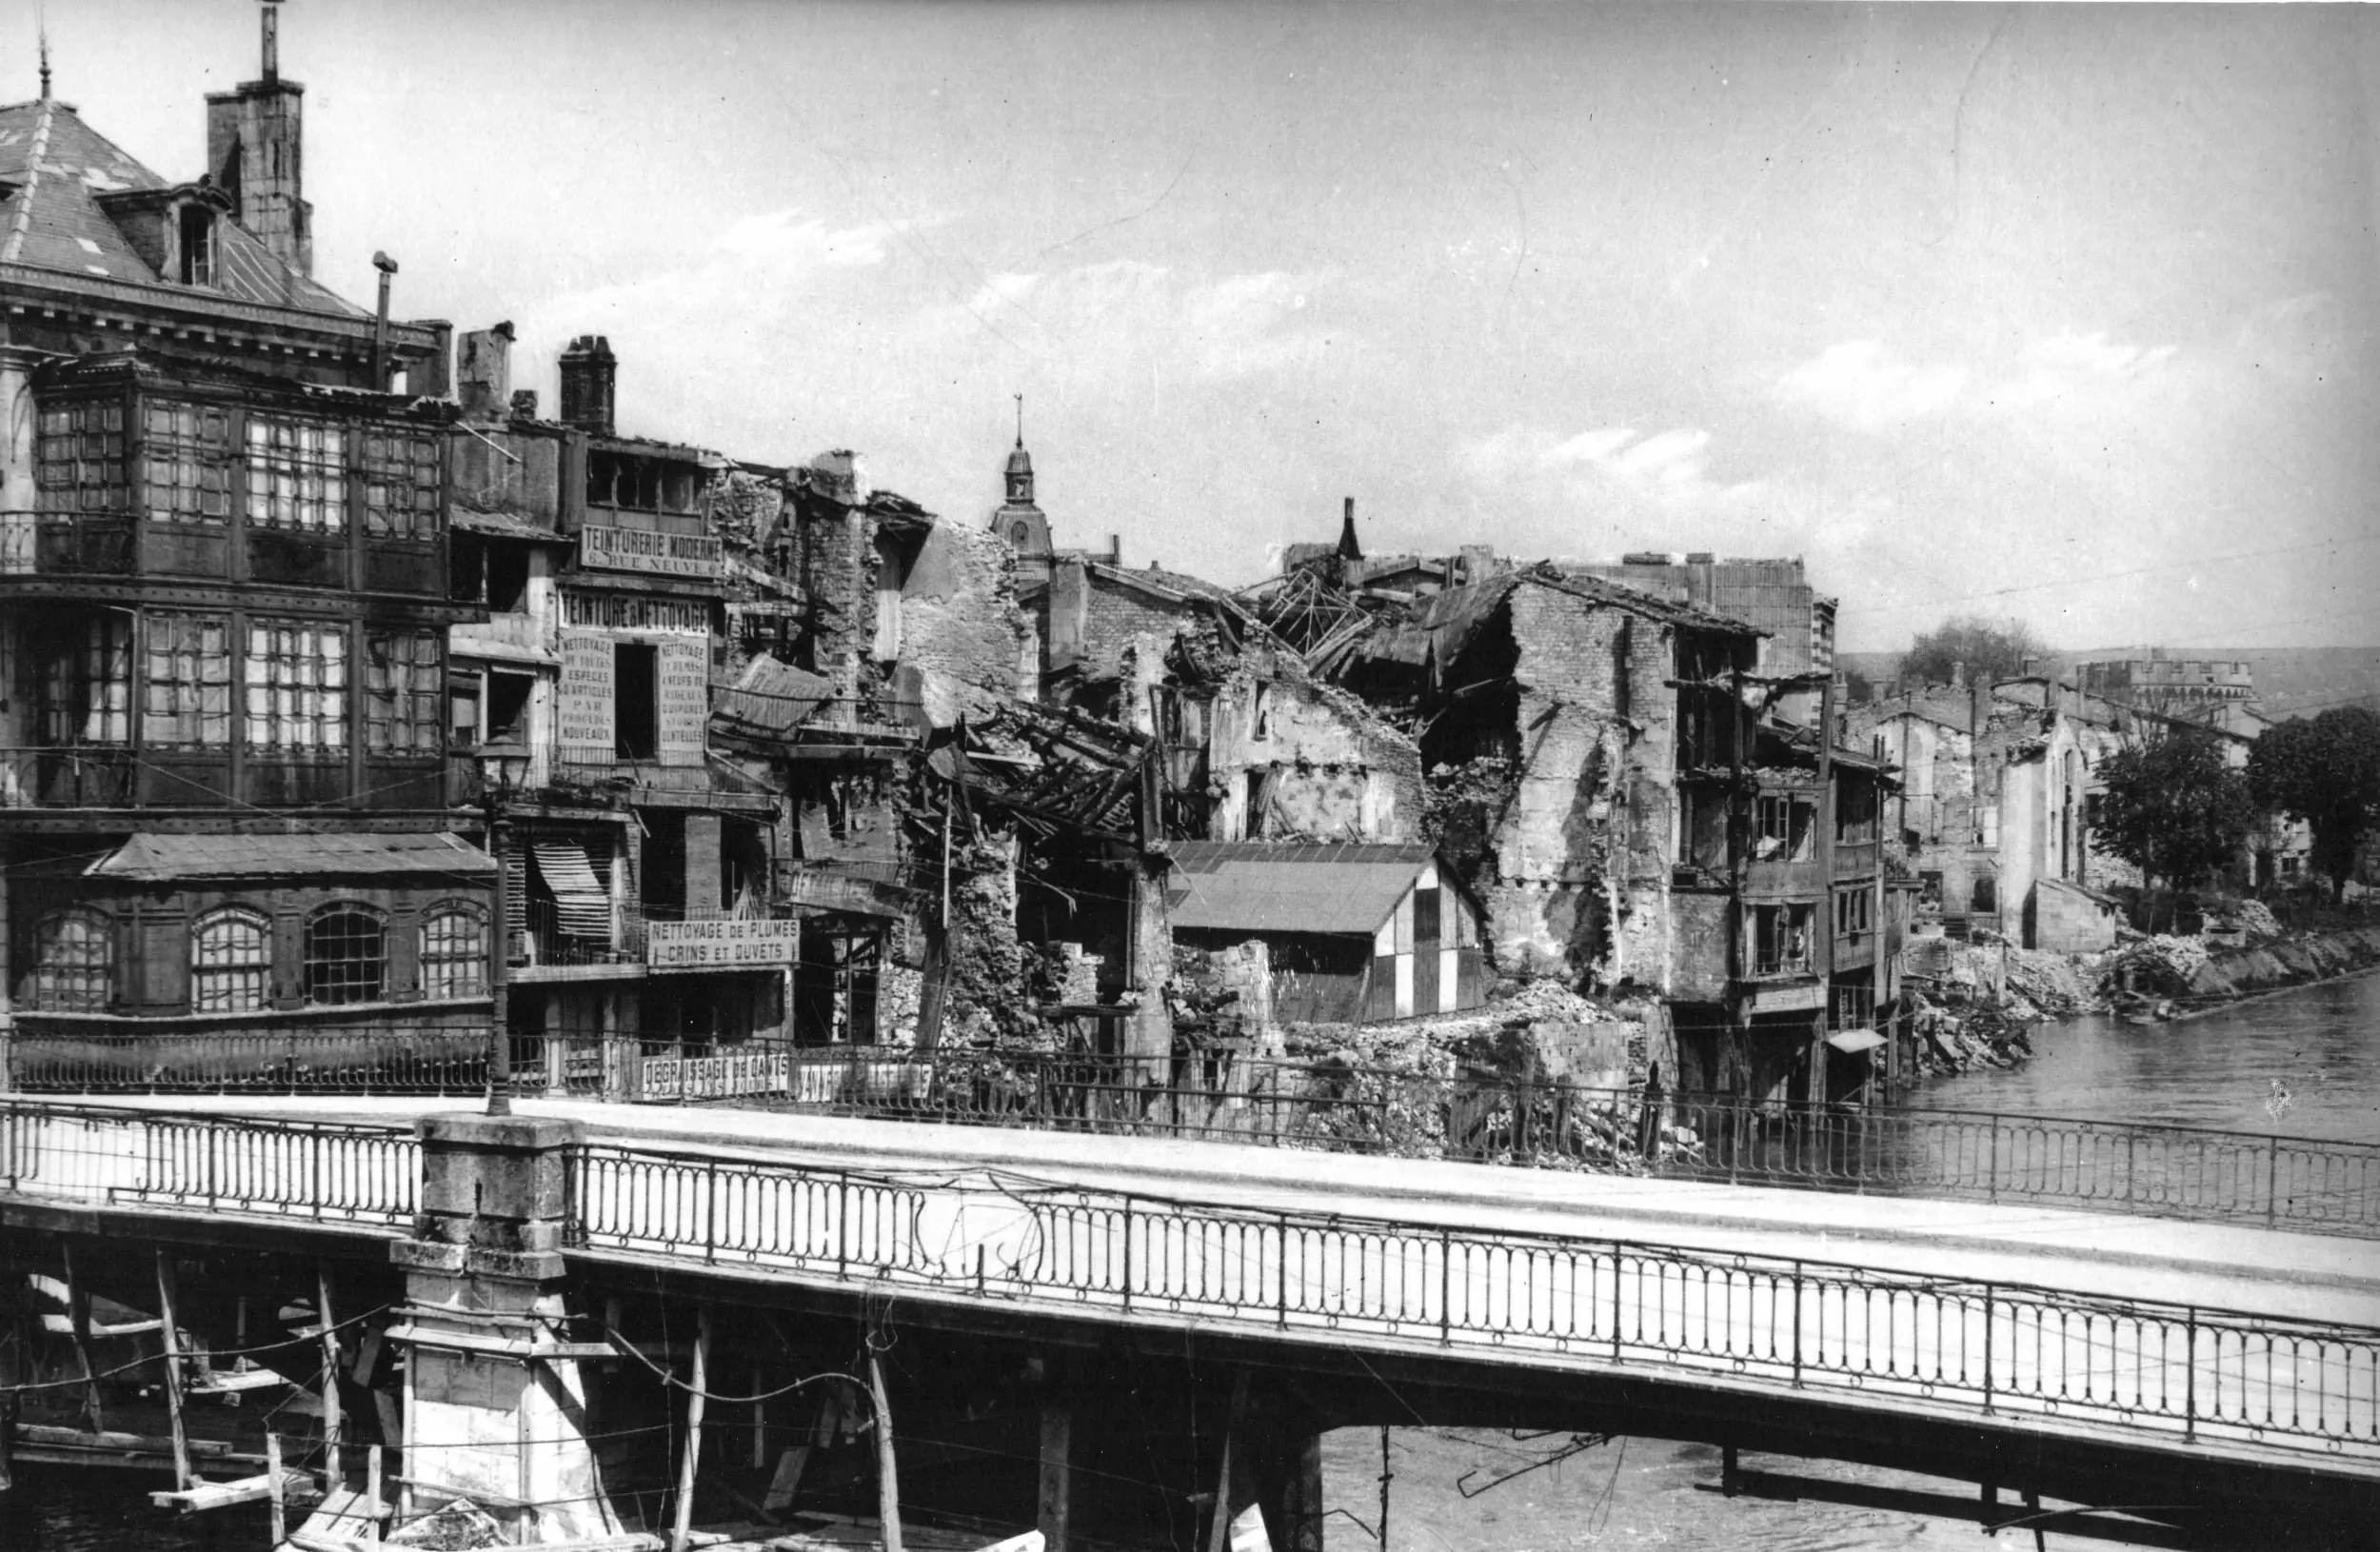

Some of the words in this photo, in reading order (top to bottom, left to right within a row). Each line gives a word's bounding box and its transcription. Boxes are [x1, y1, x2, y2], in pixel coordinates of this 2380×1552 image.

[585, 527, 664, 556] TEINTURERIE
[670, 536, 721, 562] MODERNE
[608, 554, 642, 568] RUE
[563, 593, 628, 627] TEINTURE
[638, 598, 706, 633] NETTOYAGE
[563, 637, 611, 654] NETTOYAGE
[662, 643, 704, 660] NETTOYAGE
[574, 700, 602, 711] PAR
[563, 726, 609, 741] NOUVEAUX
[652, 922, 723, 940] NETTOYAGE
[750, 921, 797, 939] PLUMES
[668, 945, 706, 962] CRINS
[714, 946, 729, 960] ET
[735, 944, 783, 960] DUVETS
